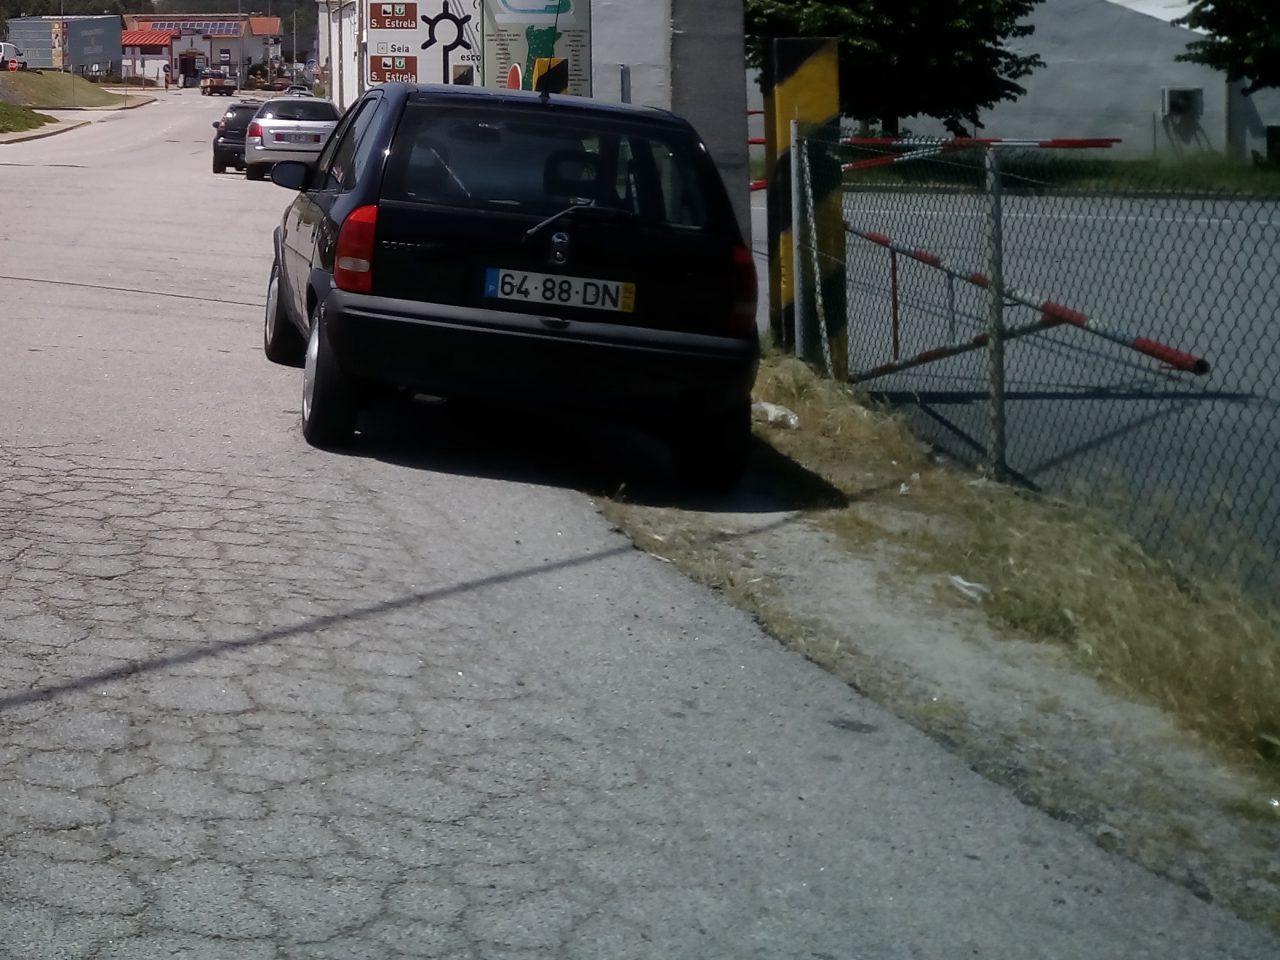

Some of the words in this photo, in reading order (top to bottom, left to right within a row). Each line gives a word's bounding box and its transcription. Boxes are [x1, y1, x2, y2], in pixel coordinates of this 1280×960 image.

[371, 18, 380, 28] S.
[385, 18, 416, 28] Estrela
[460, 54, 482, 62] esco
[371, 71, 380, 81] S.
[385, 71, 416, 83] Estrela
